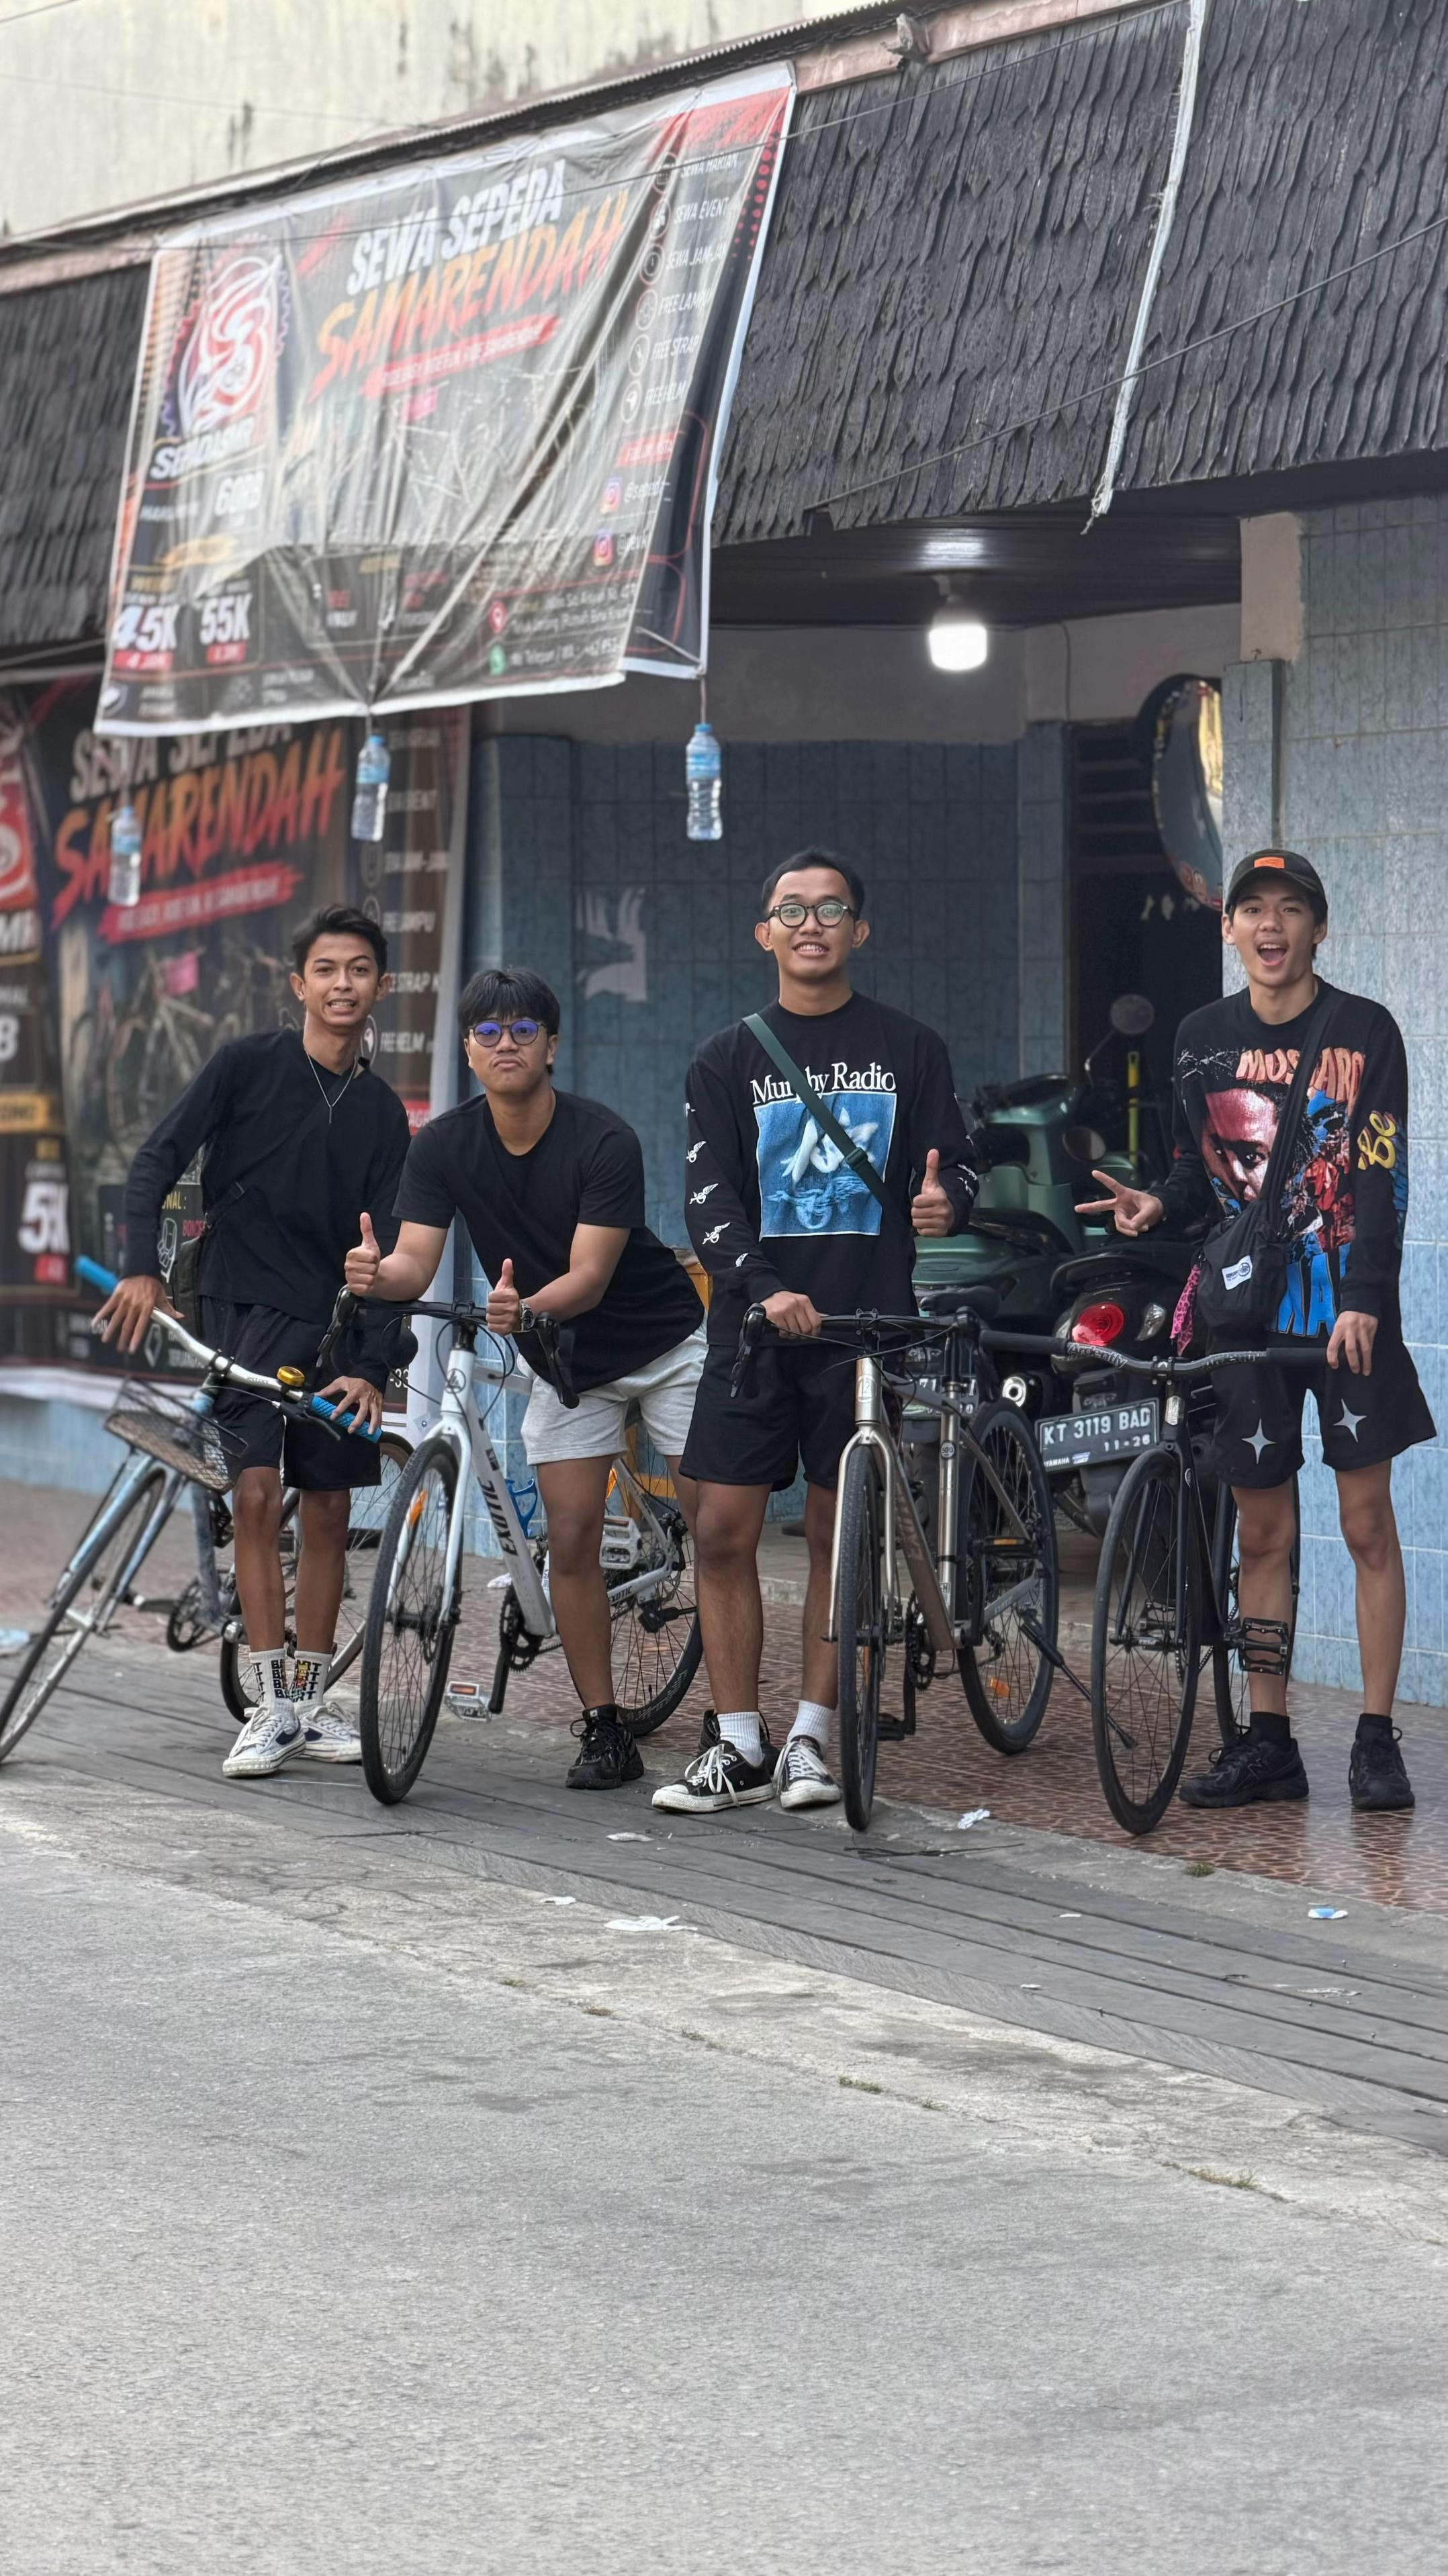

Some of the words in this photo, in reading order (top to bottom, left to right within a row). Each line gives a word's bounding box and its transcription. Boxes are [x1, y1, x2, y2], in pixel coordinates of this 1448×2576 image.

[347, 206, 439, 296] SEWA
[441, 158, 566, 260] SEPEDA
[674, 203, 697, 224] SEWA
[698, 197, 729, 219] EVENT
[307, 188, 629, 403] SAMARENDAH
[112, 604, 181, 651] 45K
[200, 593, 253, 645] 55K
[52, 728, 347, 929] SAARENDAH
[831, 1062, 897, 1091] Radio
[1236, 1047, 1365, 1117] MUSARD
[1044, 1424, 1067, 1444] KT
[1074, 1416, 1112, 1438] 3119
[1044, 1457, 1069, 1467] YAMAHA
